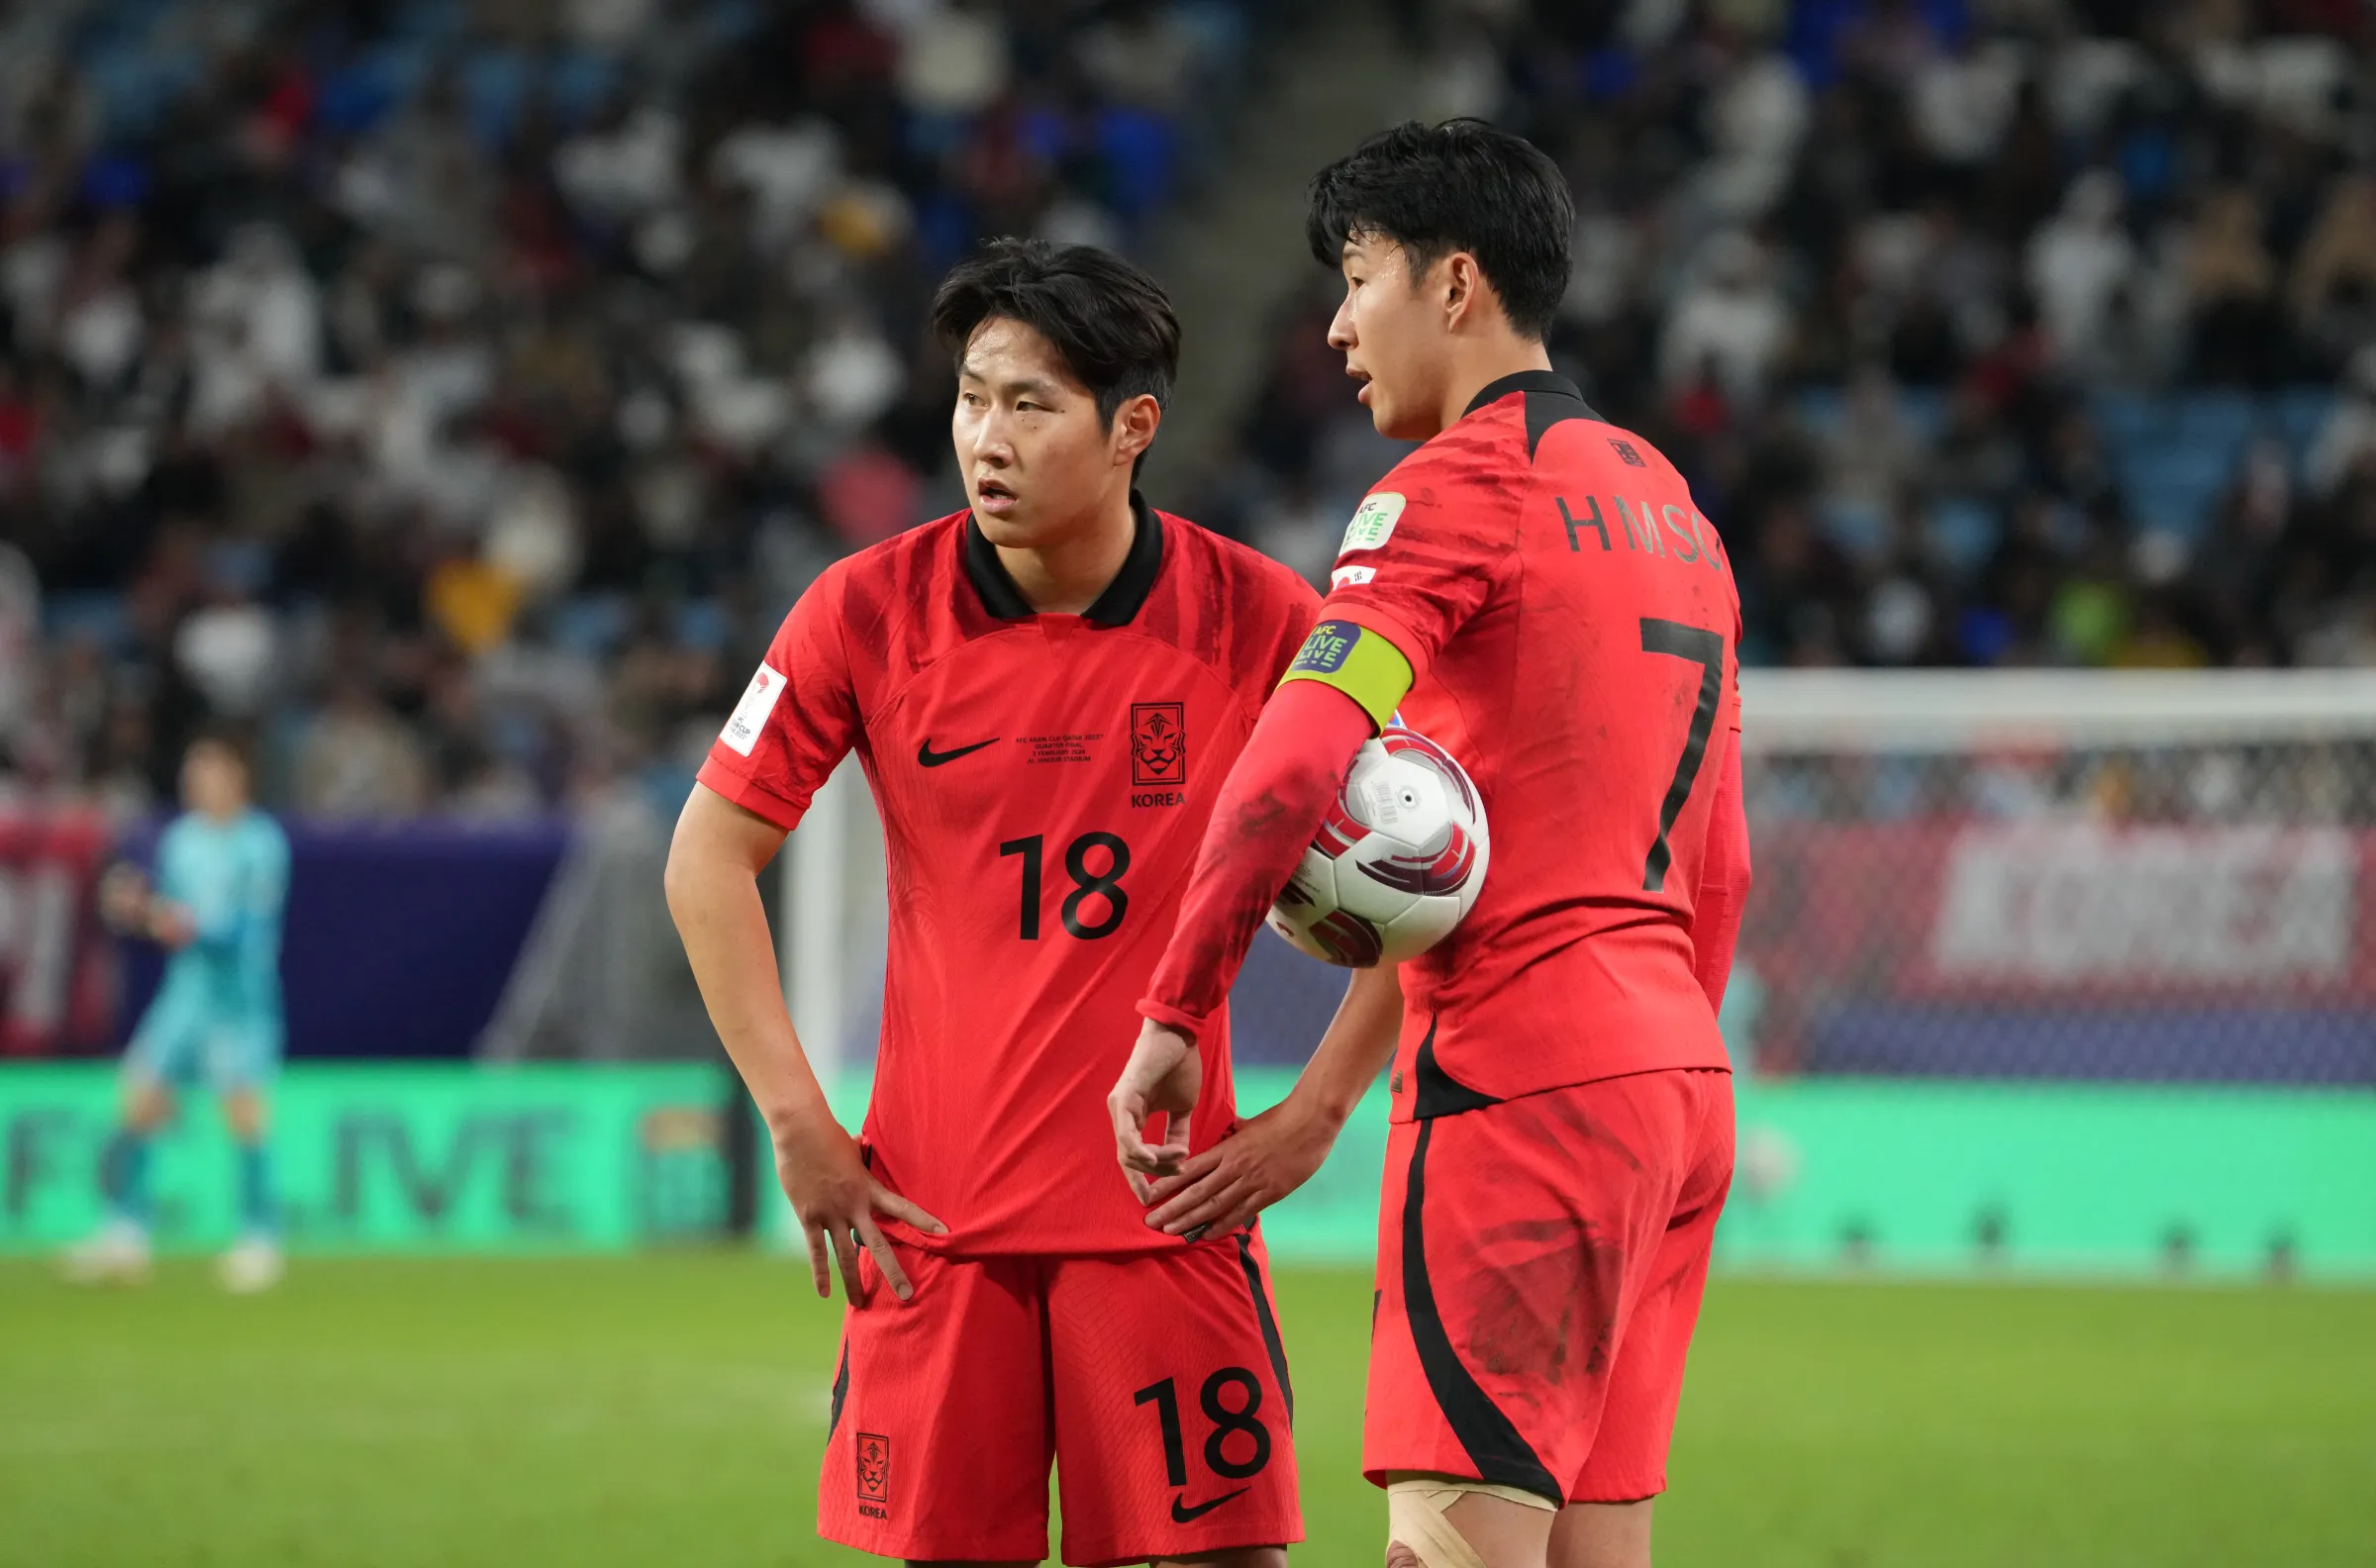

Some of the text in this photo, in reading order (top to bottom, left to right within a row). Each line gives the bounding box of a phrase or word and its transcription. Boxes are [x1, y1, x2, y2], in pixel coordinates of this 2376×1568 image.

[1315, 625, 1336, 635] AFC
[1304, 635, 1348, 654] LIVE
[1639, 617, 1725, 893] 7
[1132, 793, 1186, 808] KOREA
[1000, 831, 1131, 940] 18
[1134, 1366, 1271, 1487] 18
[858, 1504, 888, 1519] KOREA
